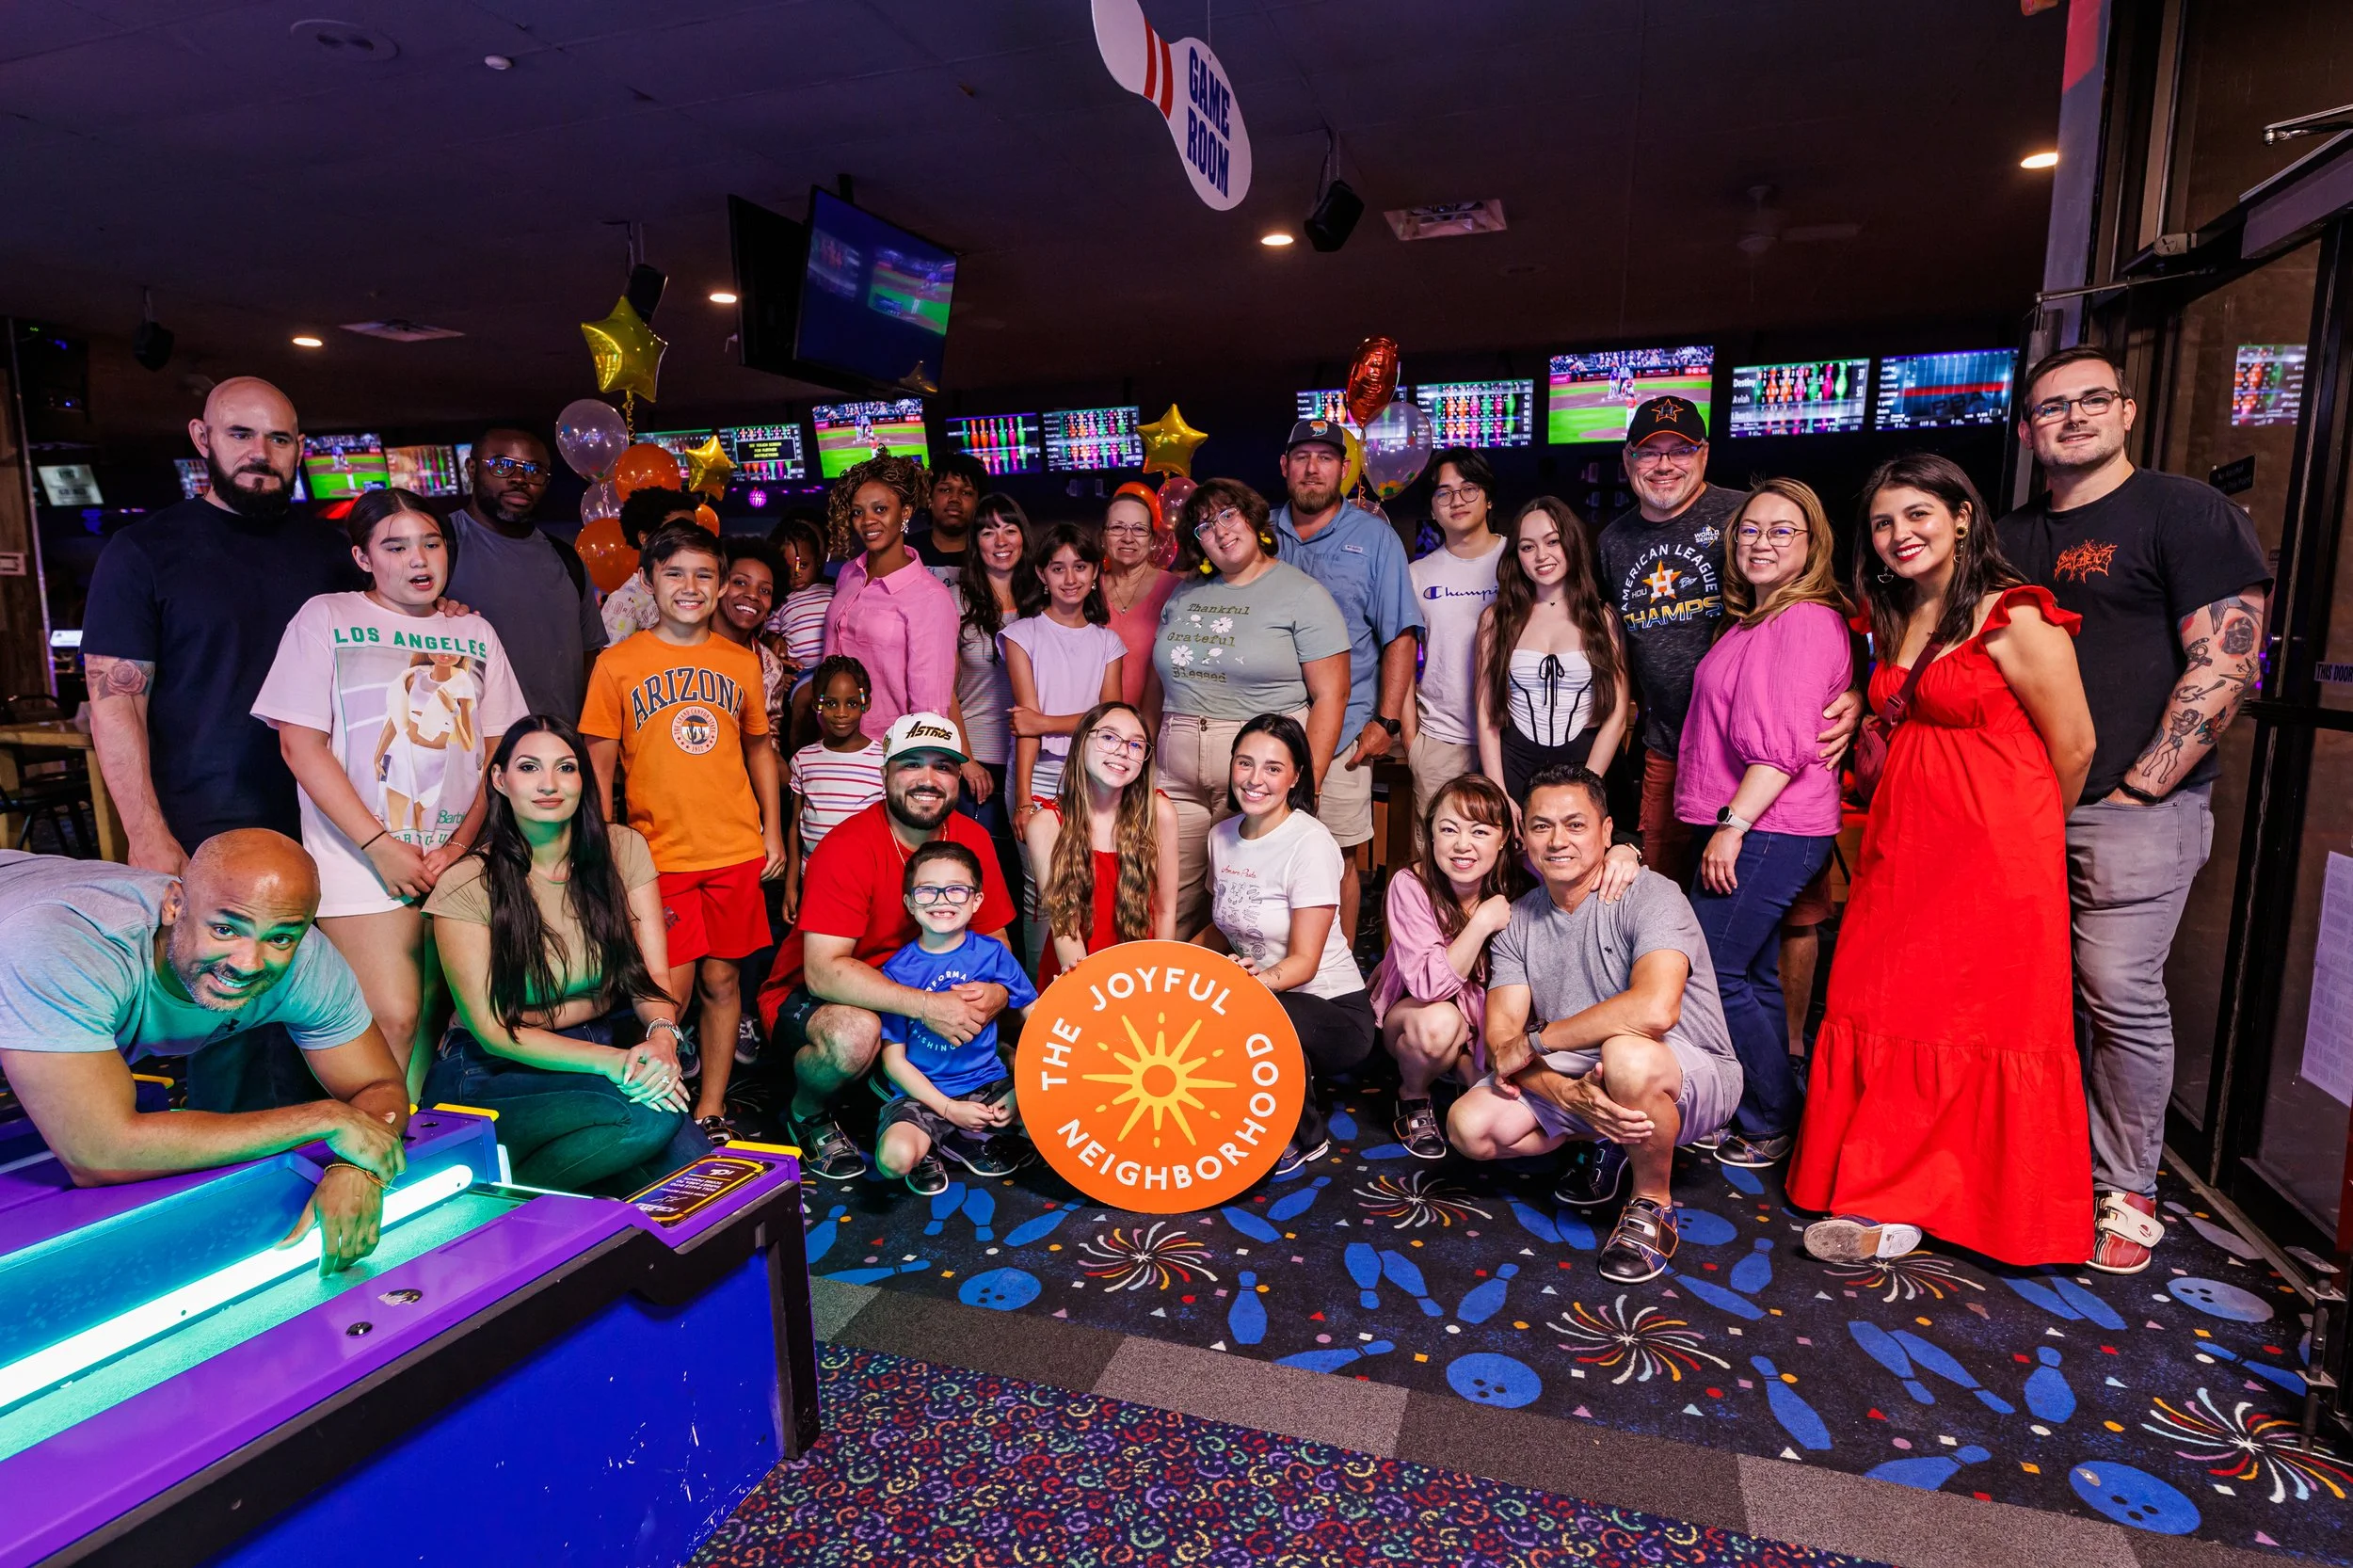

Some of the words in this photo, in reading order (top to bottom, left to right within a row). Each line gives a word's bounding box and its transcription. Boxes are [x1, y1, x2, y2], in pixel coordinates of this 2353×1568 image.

[1189, 46, 1230, 141] GAME
[1187, 105, 1229, 199] ROOM
[1733, 378, 1756, 388] Destiny
[1694, 529, 1720, 538] WORLD
[1621, 544, 1668, 612] AMERICAN
[1674, 544, 1718, 592] LEAGUE
[1649, 568, 1675, 598] H
[1423, 585, 1498, 600] Champi
[1631, 588, 1647, 599] HOU
[1187, 603, 1250, 616] Thankful
[334, 627, 379, 644] LOS
[393, 631, 487, 659] ANGELES
[1167, 632, 1236, 648] Grateful
[2316, 664, 2332, 680] THIS
[2333, 665, 2353, 682] DOOR
[631, 667, 744, 731] ARIZONA
[677, 710, 690, 725] GRAND
[691, 709, 710, 719] CANYON
[438, 809, 466, 824] Barbi
[1041, 1017, 1081, 1091] THE
[1089, 967, 1231, 1016] JOYFUL
[1056, 1032, 1279, 1190] NEIGHBORHOOD
